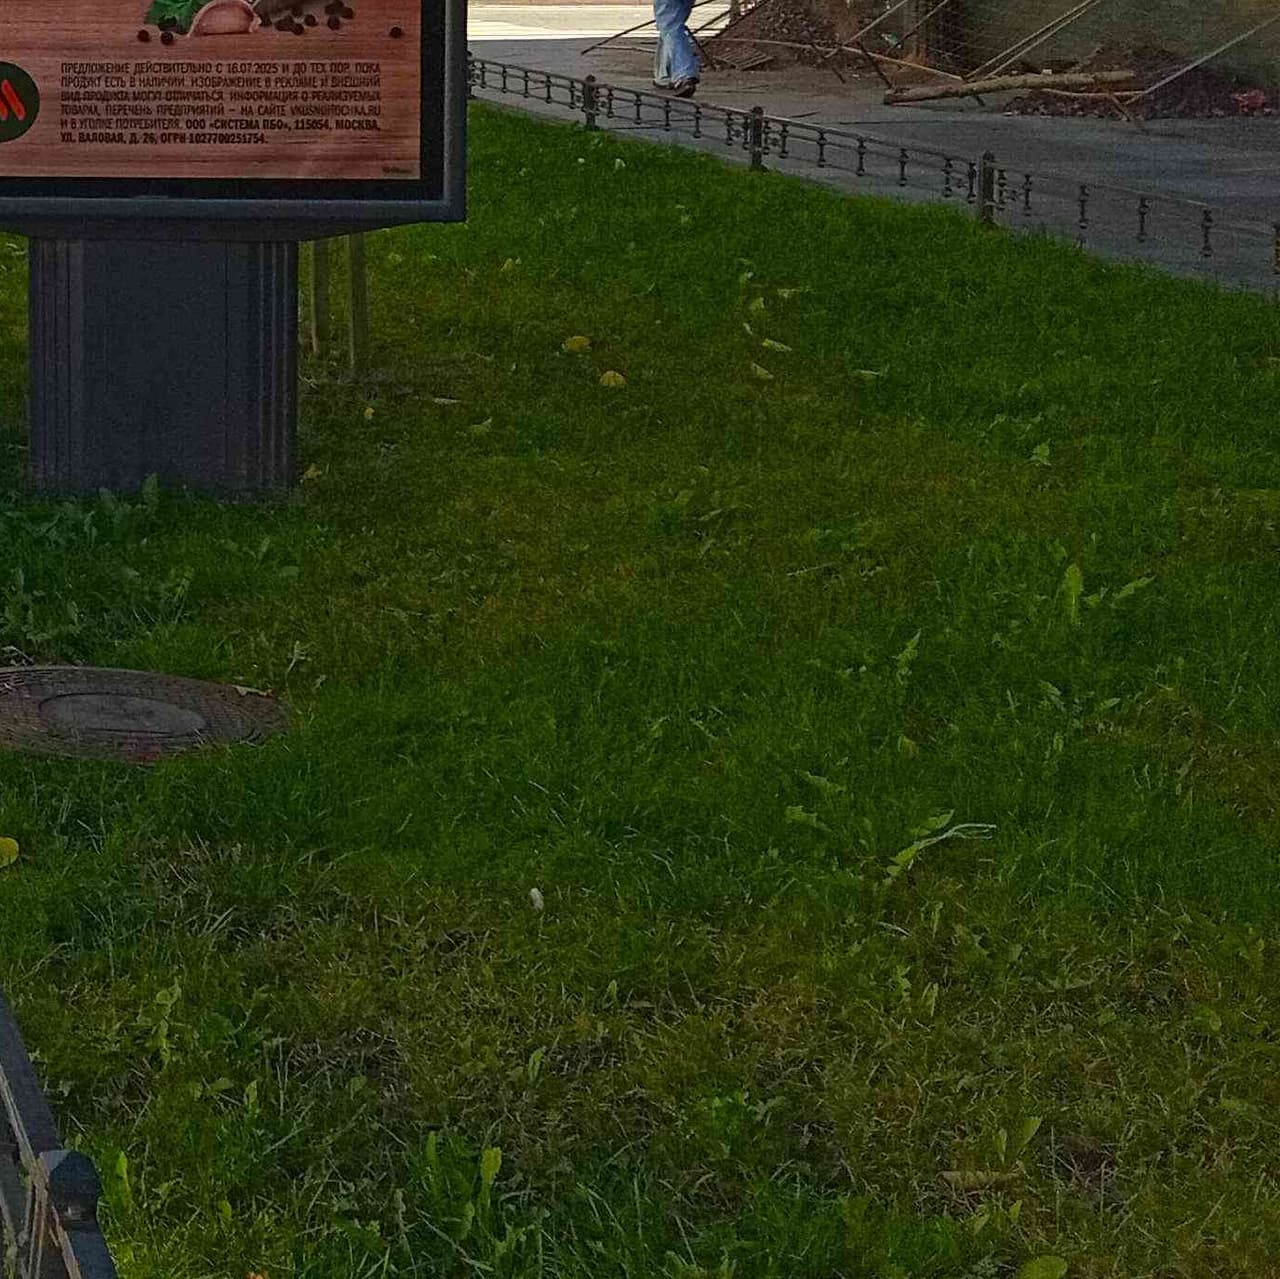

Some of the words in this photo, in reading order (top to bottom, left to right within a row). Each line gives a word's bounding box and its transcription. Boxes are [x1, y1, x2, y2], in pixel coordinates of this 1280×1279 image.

[134, 61, 212, 75] ДЕЙСТВИТЕЛЬНО
[215, 62, 223, 74] С
[292, 62, 307, 75] ДО
[105, 76, 126, 88] ЕСТЬ
[185, 118, 206, 130] ООО
